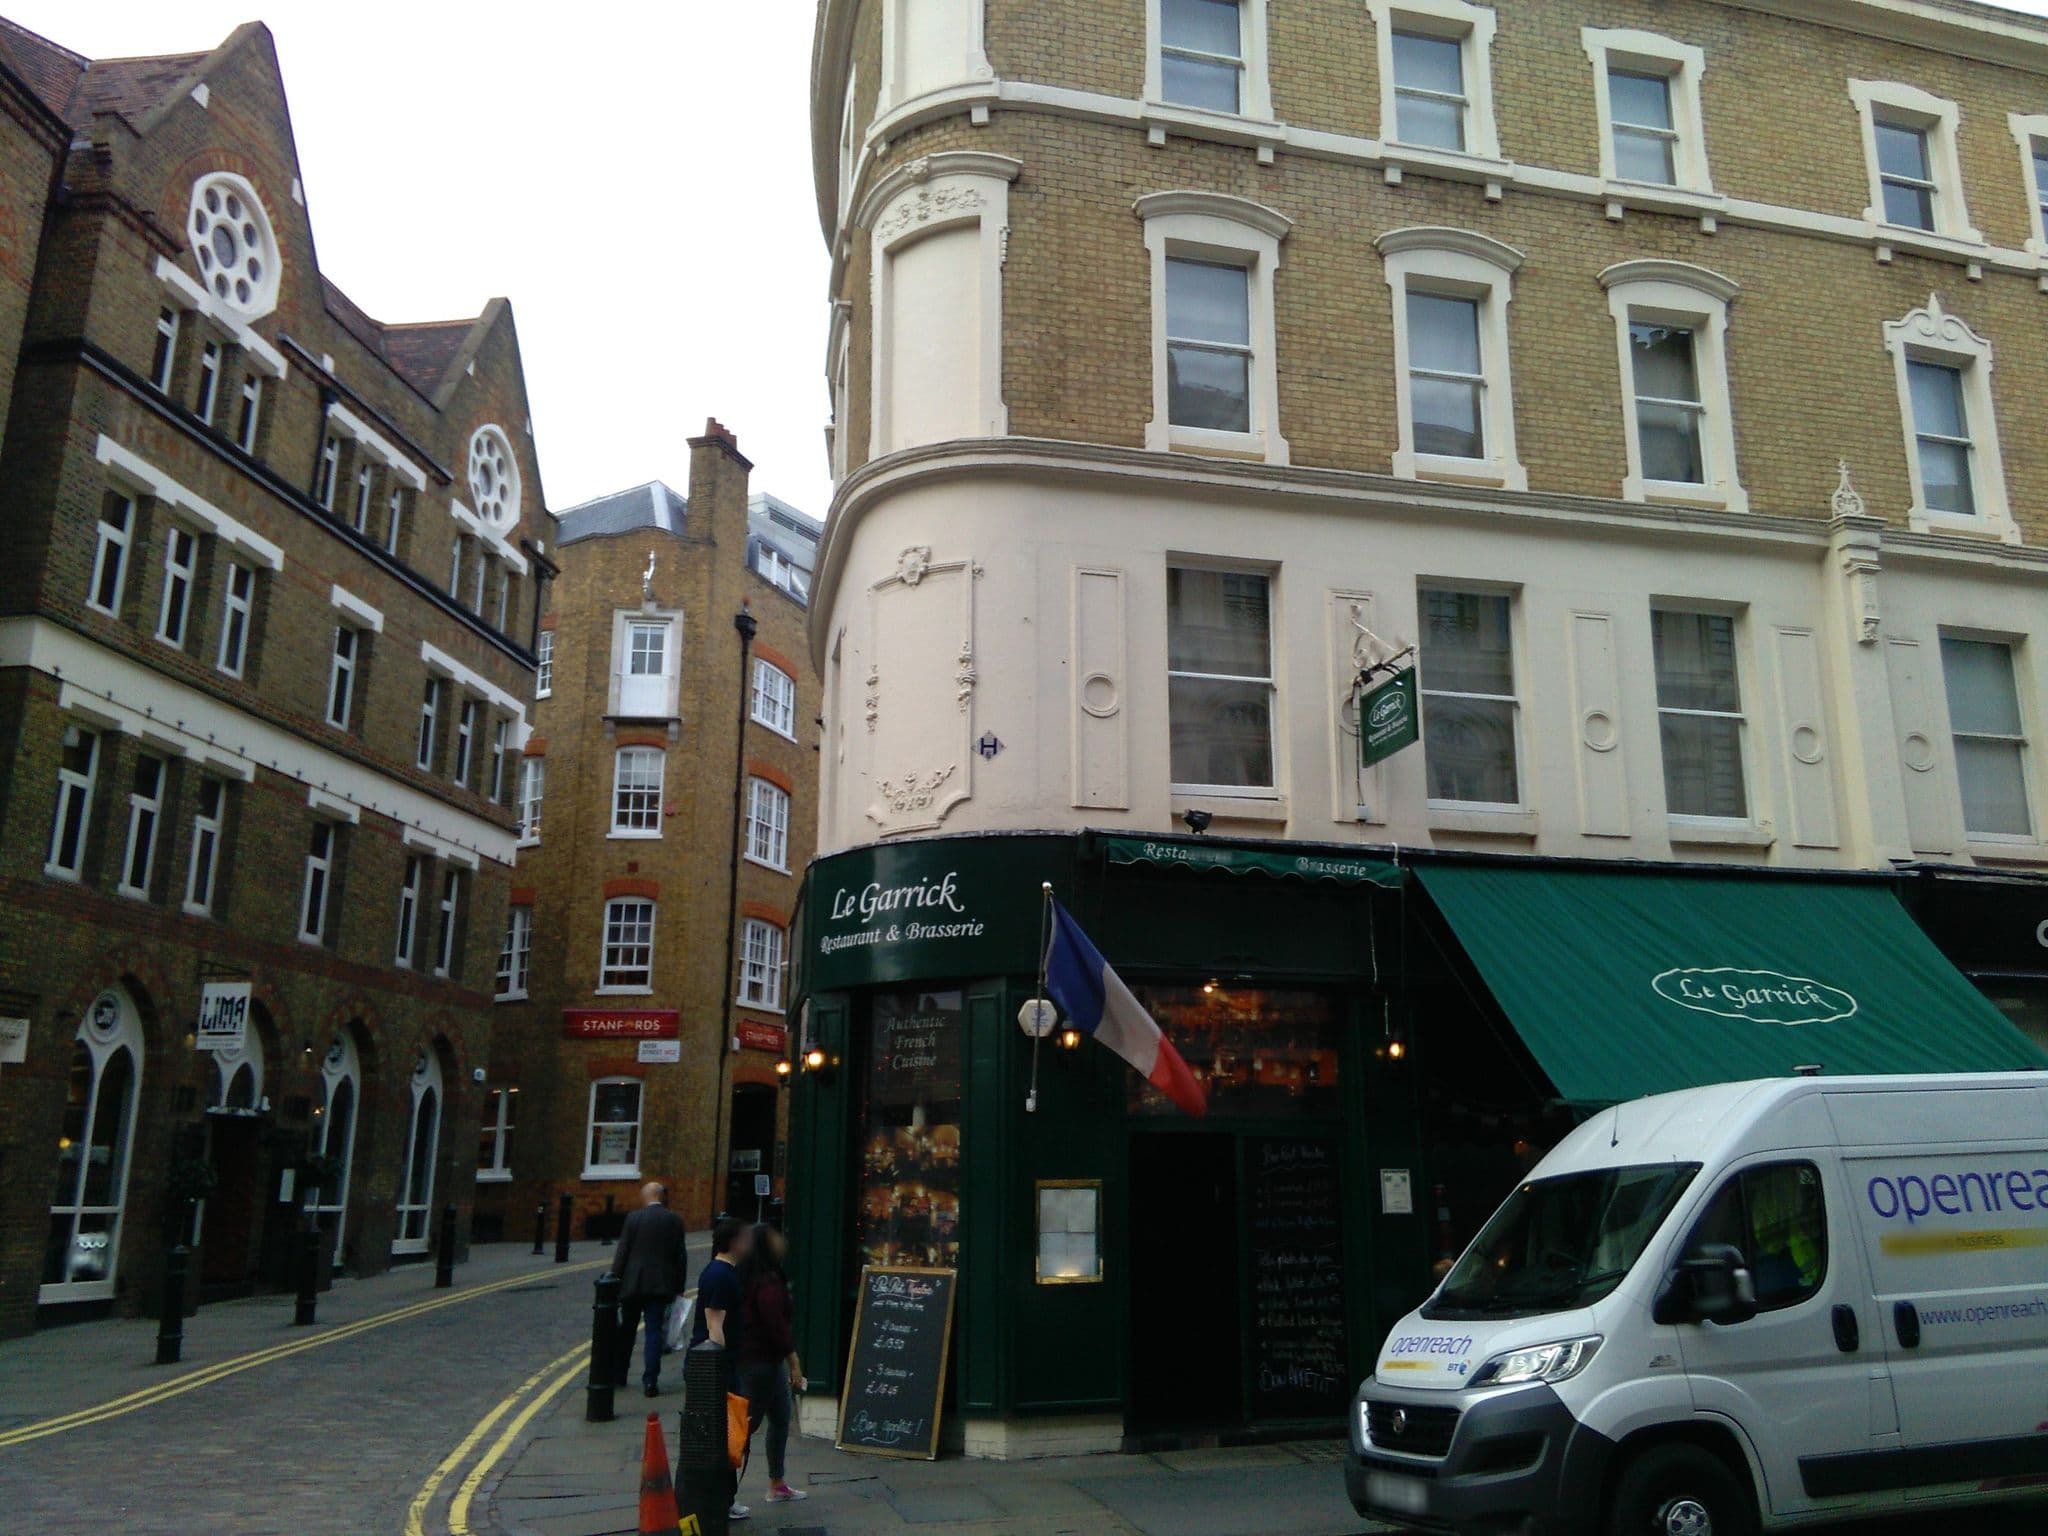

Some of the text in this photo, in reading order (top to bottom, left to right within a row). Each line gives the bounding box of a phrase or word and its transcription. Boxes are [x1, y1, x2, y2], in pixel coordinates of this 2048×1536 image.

[831, 872, 965, 924] Le Garrick
[820, 918, 984, 955] Restaurant & Brasserie
[1680, 978, 1838, 1009] Le Garrick
[883, 1015, 948, 1033] Authentic
[895, 1031, 936, 1049] French
[892, 1054, 937, 1070] Cuisine
[1391, 1335, 1472, 1357] openreach
